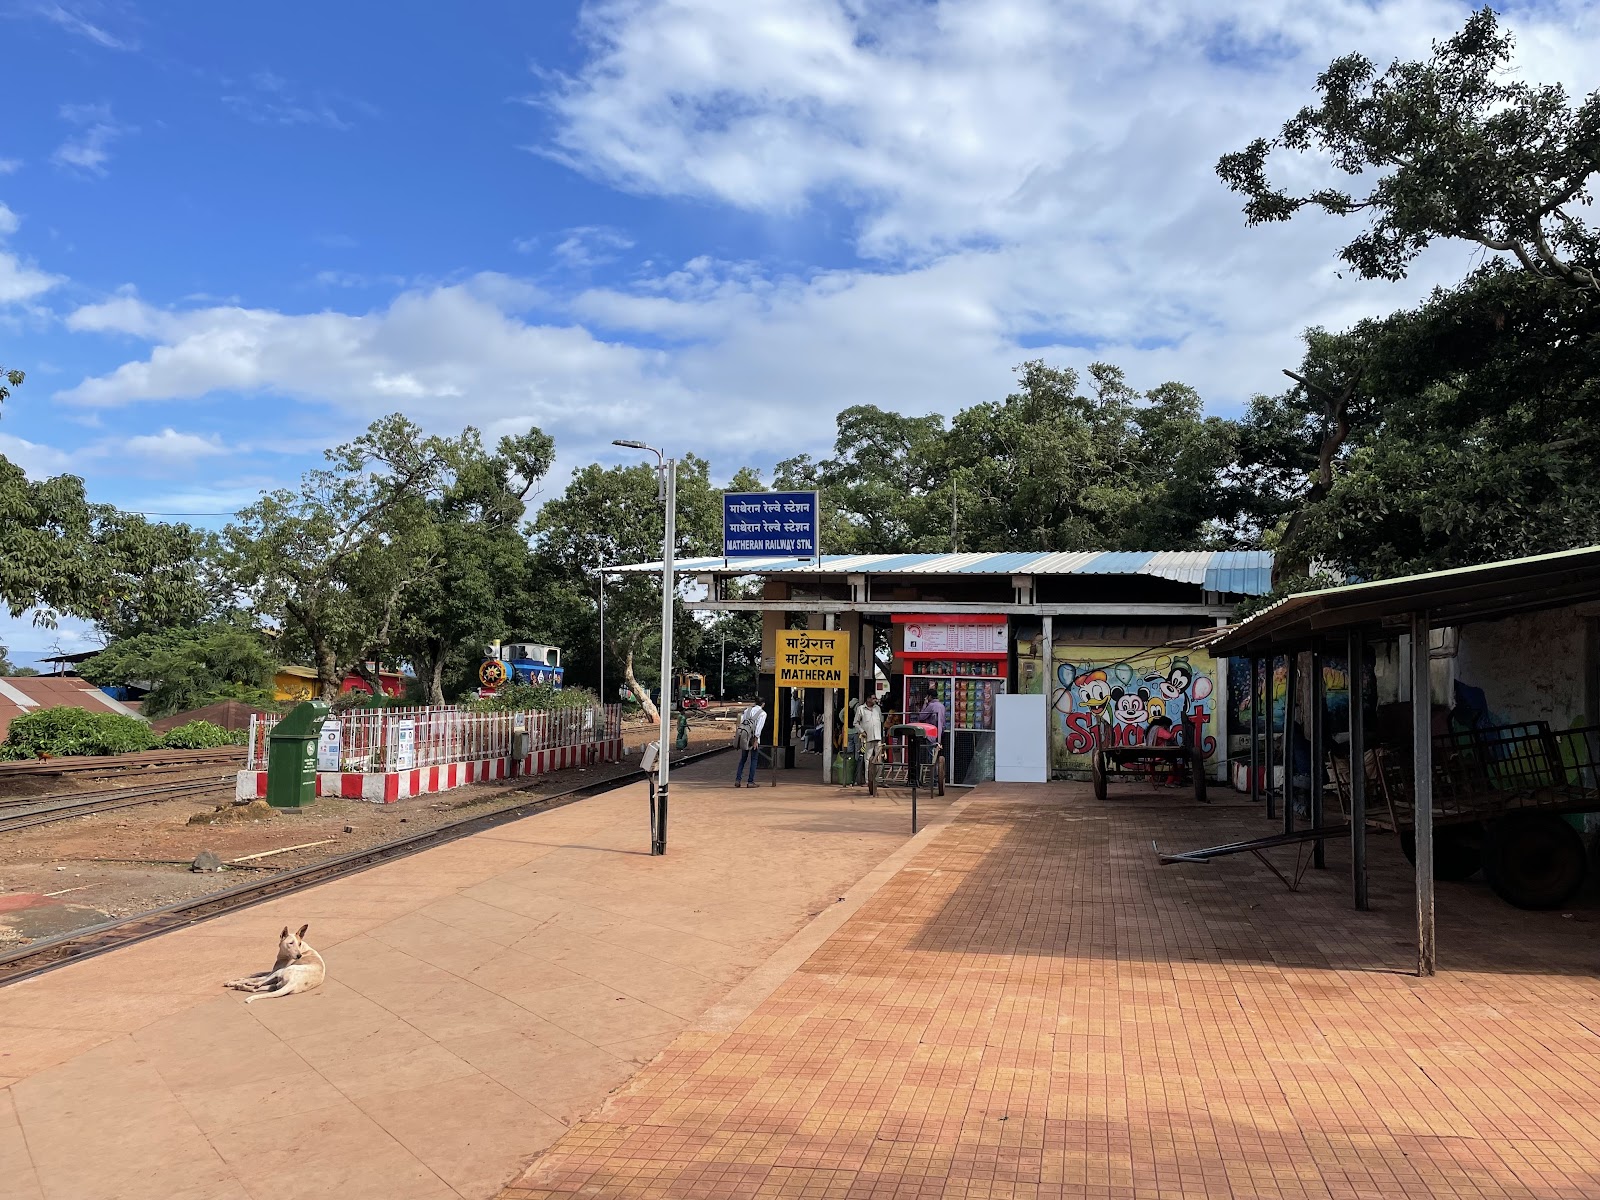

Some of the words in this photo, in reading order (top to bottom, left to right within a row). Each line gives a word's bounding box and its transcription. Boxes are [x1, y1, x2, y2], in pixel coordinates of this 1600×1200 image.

[729, 501, 761, 513] माथेरान
[762, 501, 781, 513] रेल्वे
[783, 500, 810, 513] स्टेशन
[729, 520, 761, 532] माथेरान
[762, 520, 781, 532] रेल्वे
[783, 519, 810, 532] स्टेशन
[727, 540, 763, 550] MATHERAN
[765, 539, 795, 550] RAILWAY
[796, 539, 812, 549] STN.
[785, 633, 835, 650] माथेरान
[785, 650, 834, 666] माथेरान
[781, 669, 841, 680] MATHERAN
